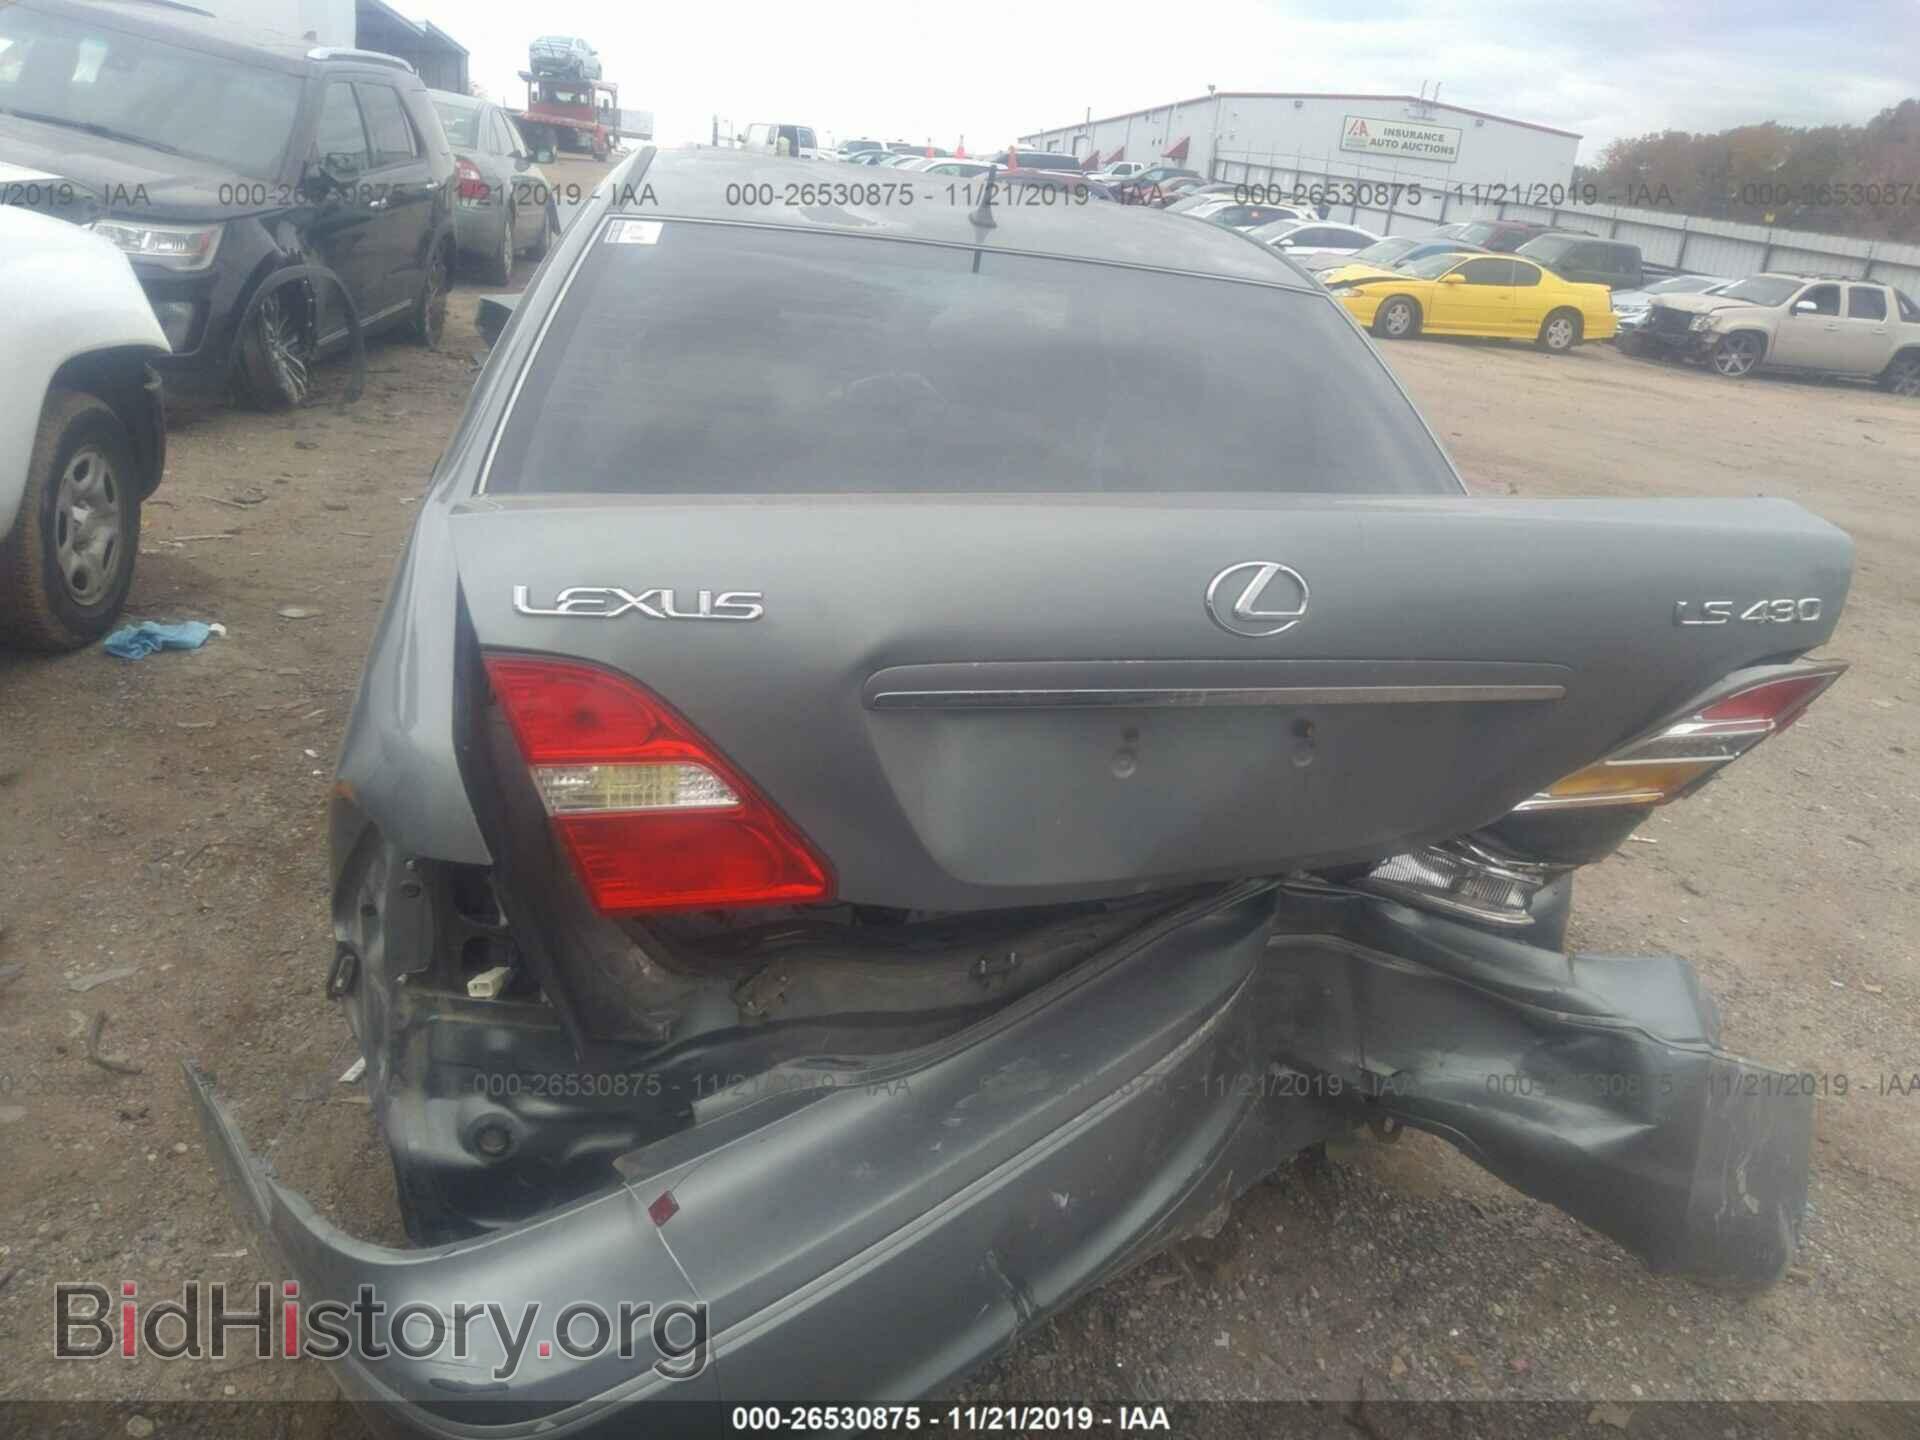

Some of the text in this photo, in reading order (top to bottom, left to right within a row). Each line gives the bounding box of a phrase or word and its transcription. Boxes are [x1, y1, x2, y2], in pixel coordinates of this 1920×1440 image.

[1384, 127, 1445, 142] INSURANCE
[1369, 138, 1399, 149] AUTO
[1401, 141, 1456, 155] AUCTIONS
[512, 584, 765, 620] LEXUS
[1673, 597, 1822, 626] LS 430
